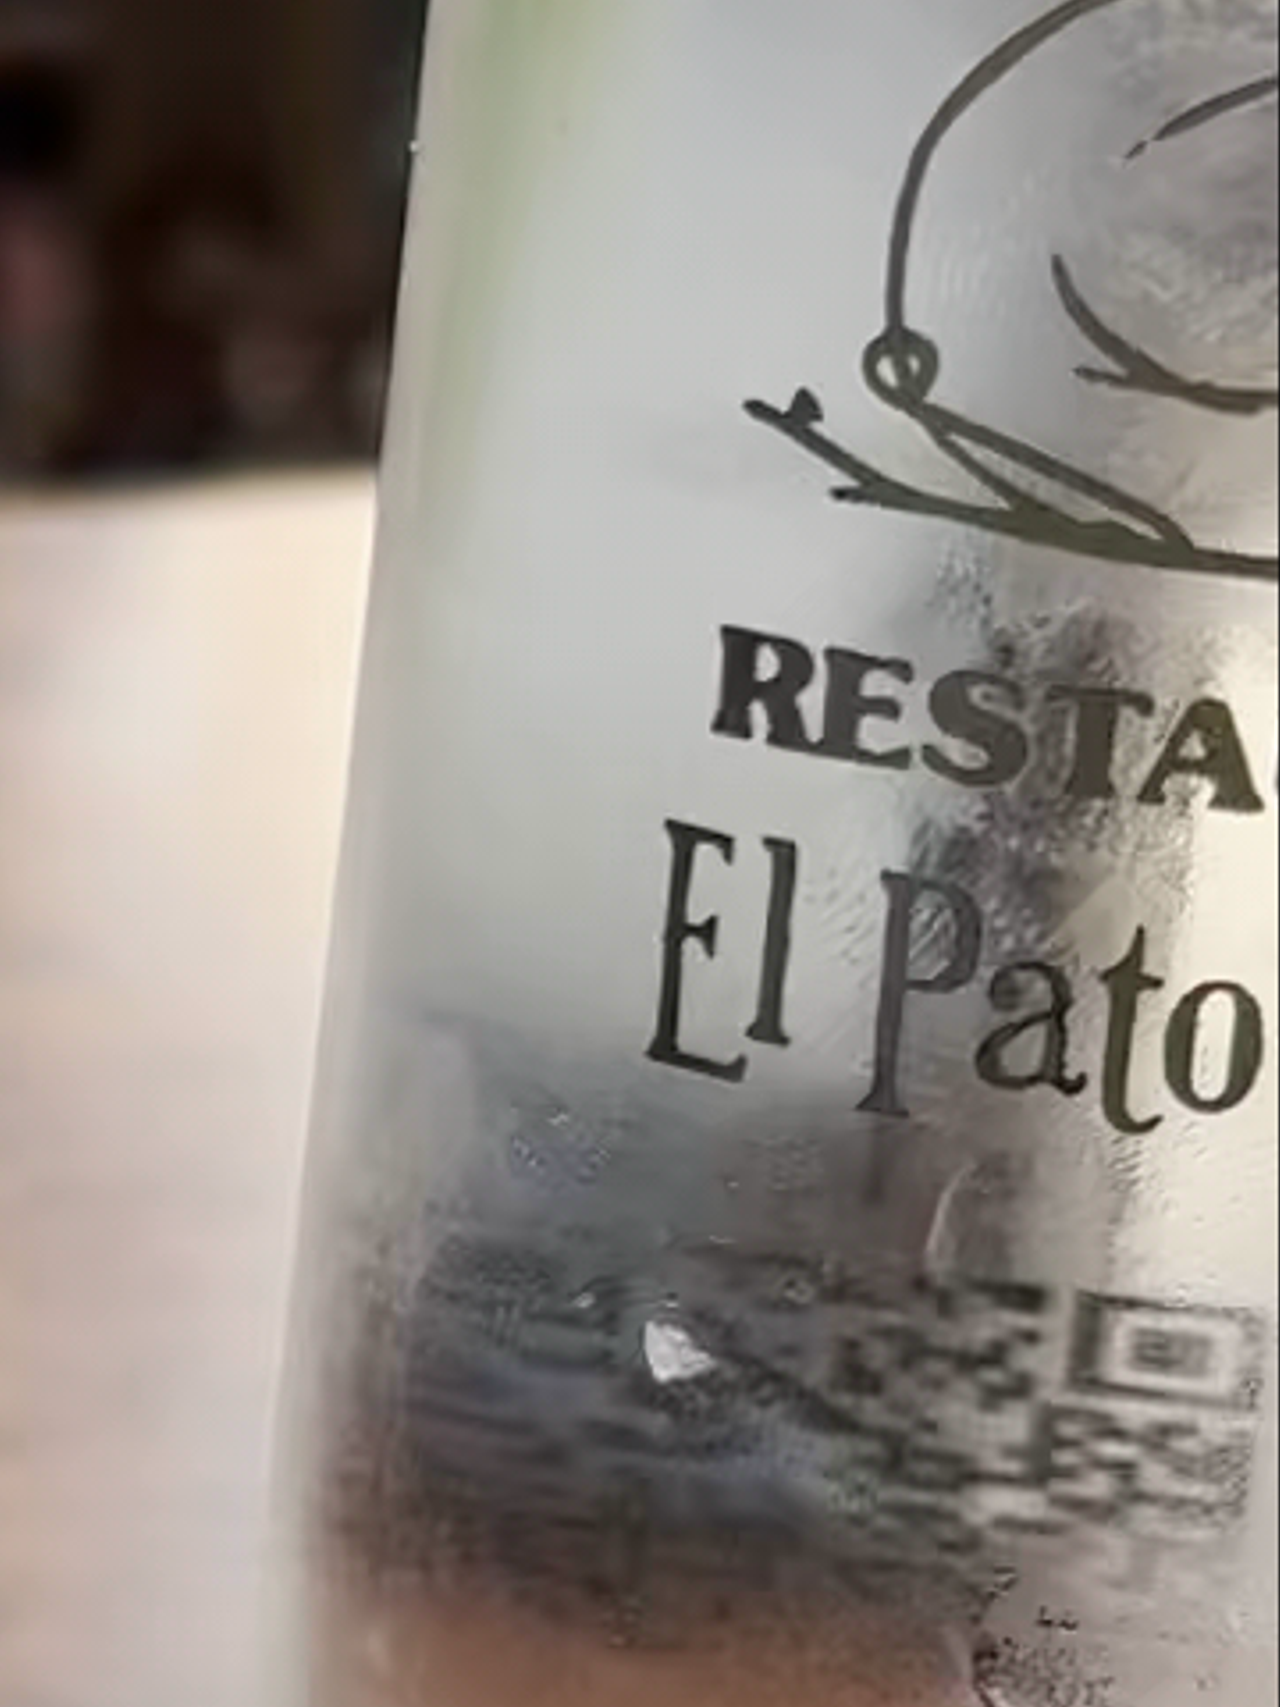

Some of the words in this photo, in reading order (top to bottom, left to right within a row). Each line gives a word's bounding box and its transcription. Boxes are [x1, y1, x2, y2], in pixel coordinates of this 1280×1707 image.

[710, 624, 1280, 813] RESTA
[644, 817, 799, 1082] El
[857, 868, 1266, 1134] Pato
